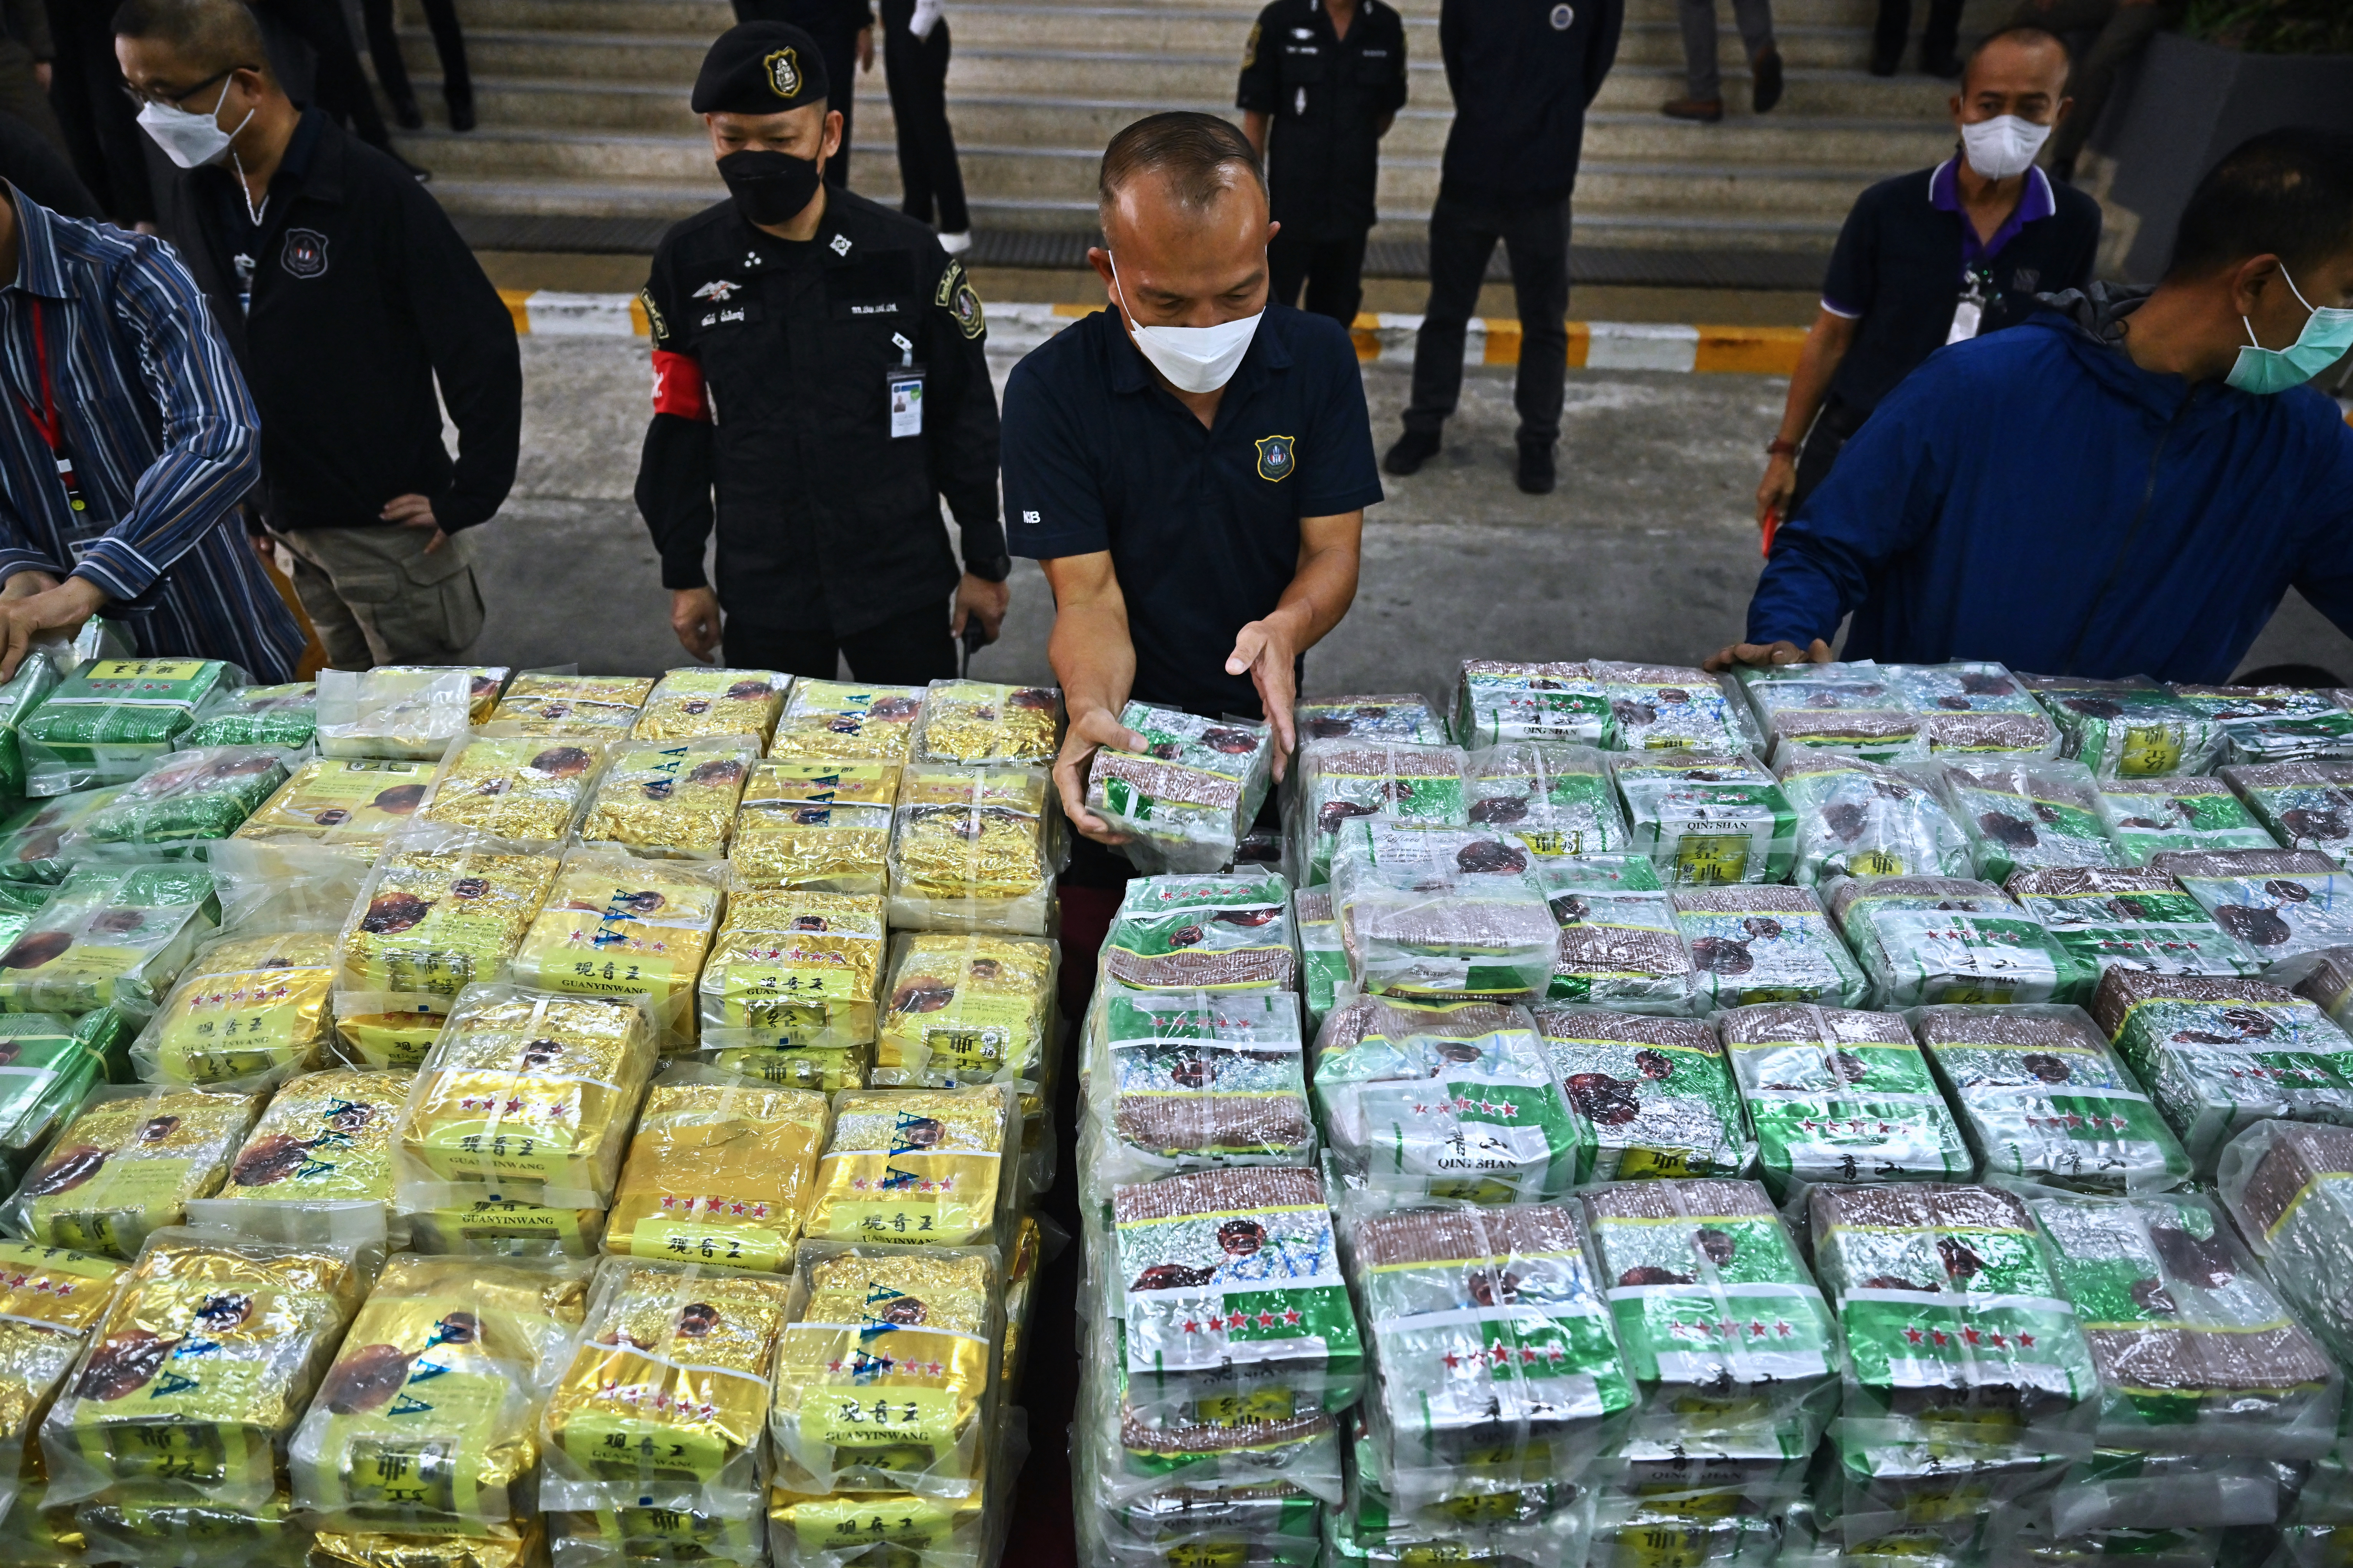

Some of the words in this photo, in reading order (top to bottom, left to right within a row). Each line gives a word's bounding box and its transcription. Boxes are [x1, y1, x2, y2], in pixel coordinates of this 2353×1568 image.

[1523, 726, 1547, 734] QING
[1548, 727, 1578, 736] SHAN
[1687, 822, 1713, 830] QING
[1716, 822, 1748, 830] SHAN
[1375, 834, 1420, 844] Refined
[593, 888, 641, 950] AAA
[573, 961, 641, 981] 观音王
[562, 979, 647, 994] GUANYINWANG
[976, 1015, 1017, 1026] Refined
[459, 1134, 534, 1157] 观音王
[883, 1110, 931, 1190] AAA
[1438, 1158, 1472, 1170] QING
[1475, 1158, 1517, 1169] SHAN
[1835, 1153, 1905, 1179] 青山
[462, 1214, 554, 1225] GUANYINWANG
[861, 1212, 935, 1233] 观音王
[666, 1235, 742, 1258] 观音王
[861, 1233, 940, 1244] UANYINWAN
[853, 1281, 906, 1378] AAA
[387, 1319, 467, 1417] AAA
[839, 1399, 920, 1424] 观音王
[825, 1430, 929, 1442] GUANYINWANG
